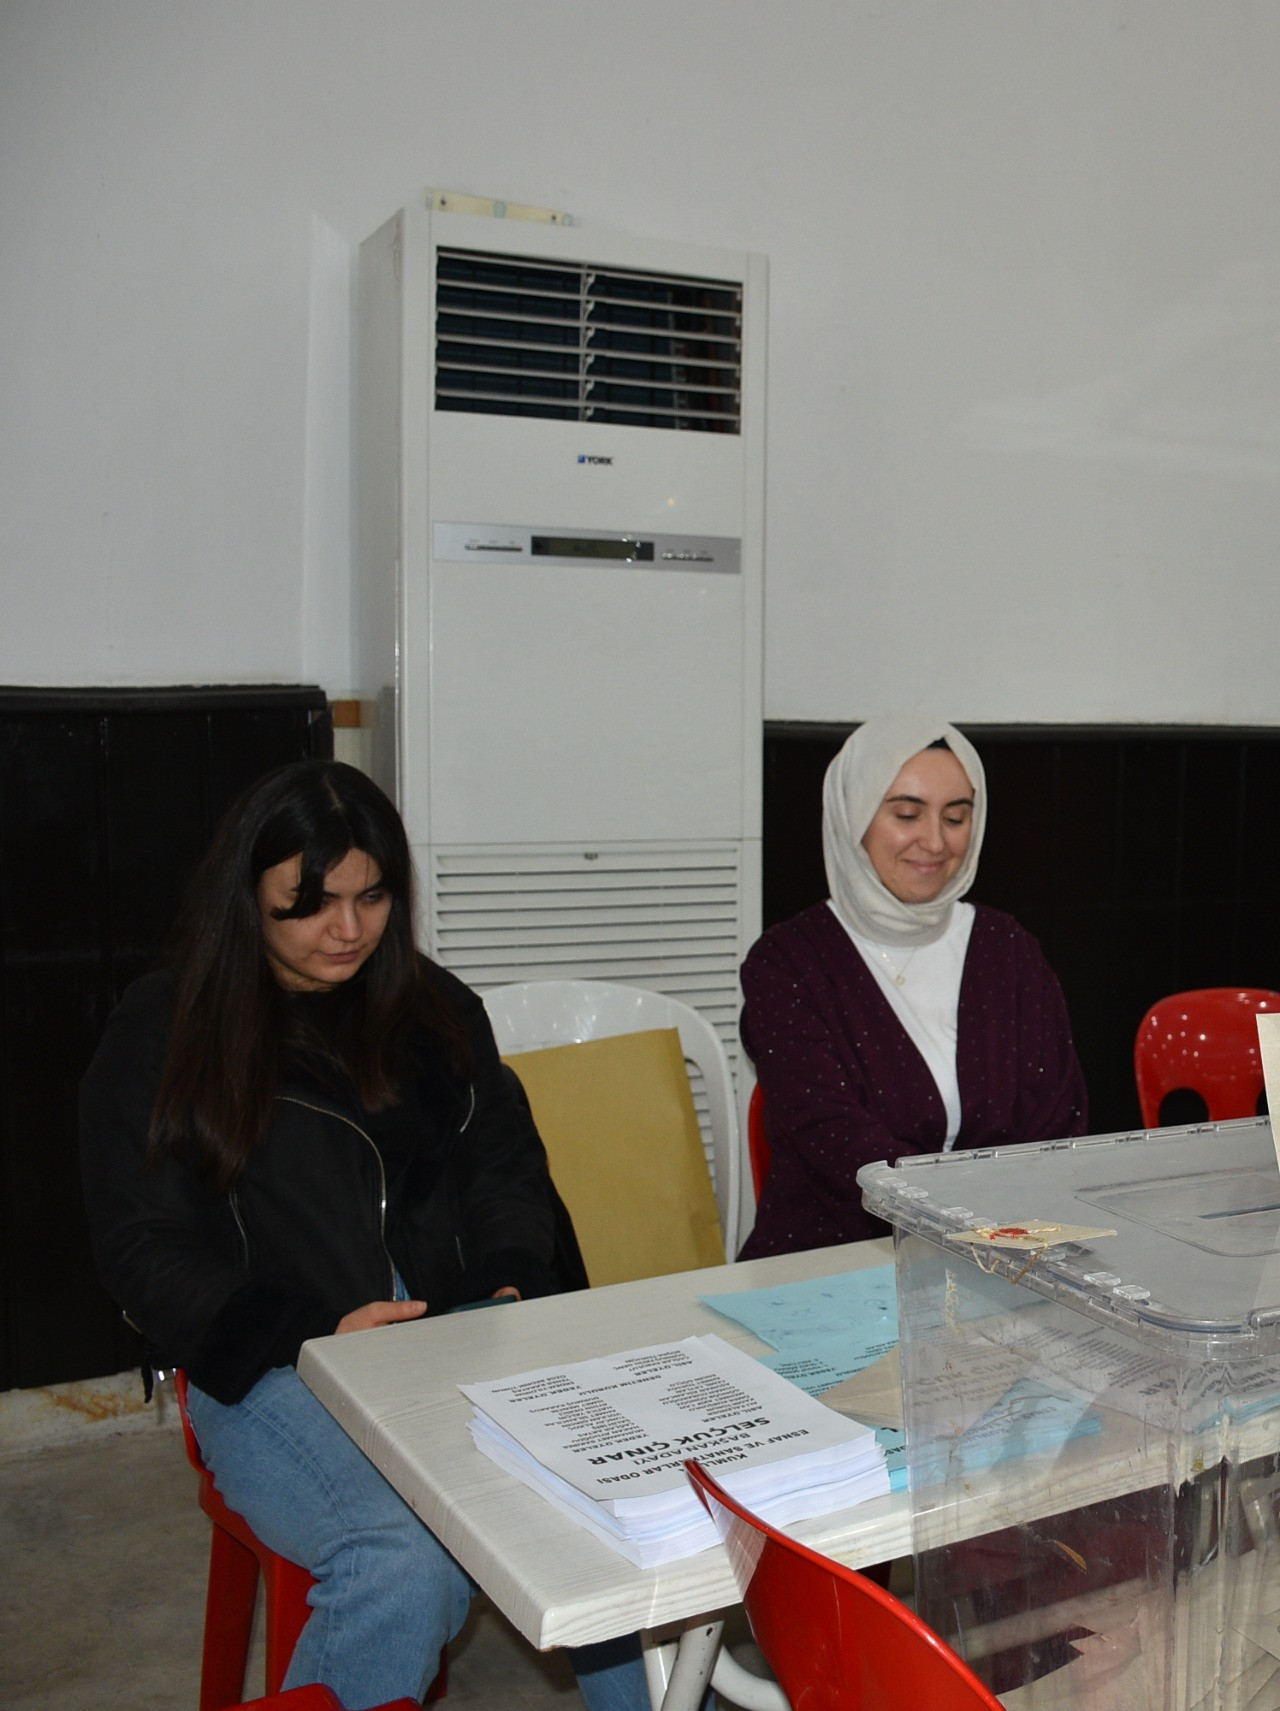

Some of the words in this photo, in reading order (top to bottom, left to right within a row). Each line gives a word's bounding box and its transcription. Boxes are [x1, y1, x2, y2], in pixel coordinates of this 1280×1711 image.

[674, 1417, 769, 1444] SELÇUK
[768, 1429, 808, 1443] ESNAF
[685, 1432, 750, 1451] BAŞKAN
[588, 1441, 669, 1464] ÇINAR
[633, 1449, 681, 1465] ADAYI
[596, 1472, 640, 1483] ODASI
